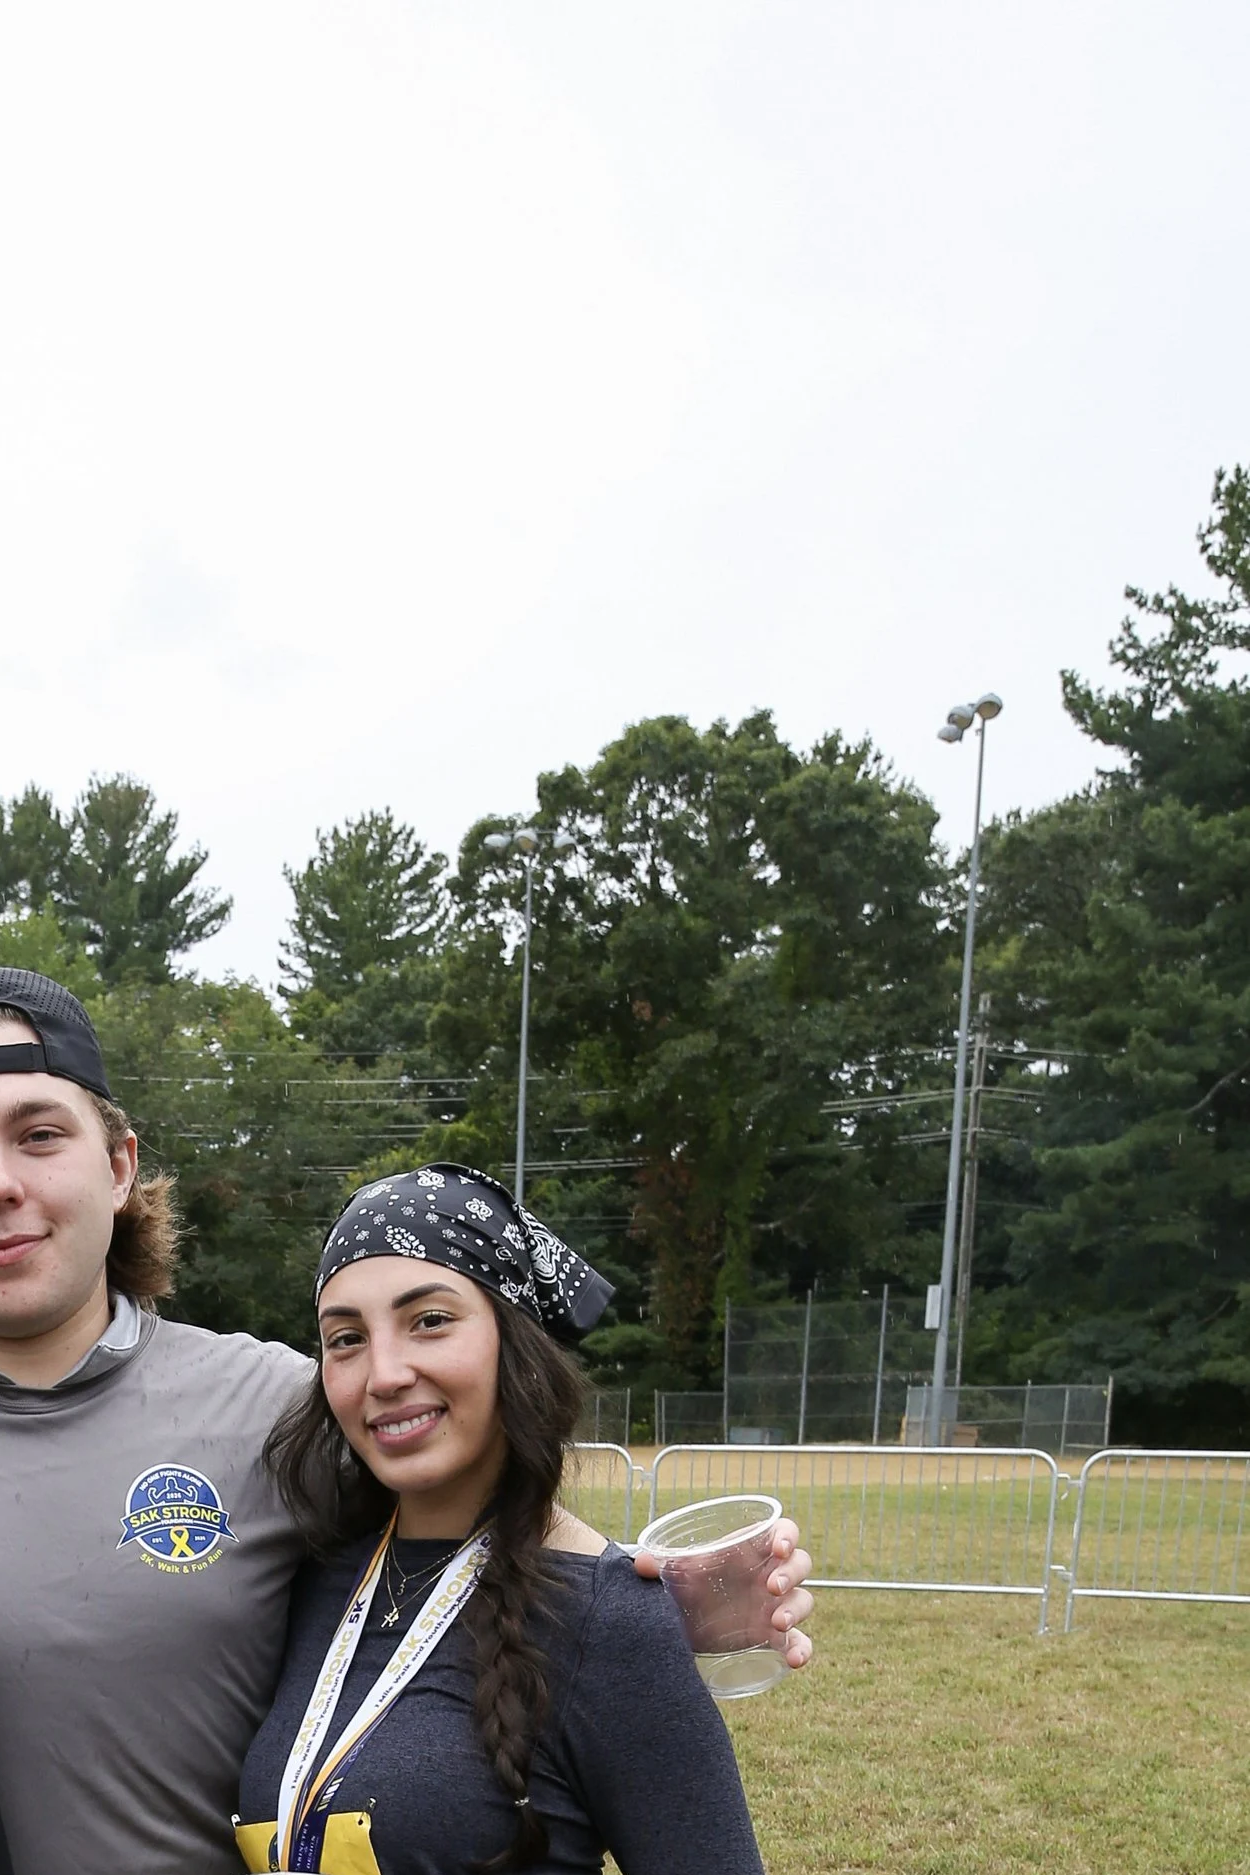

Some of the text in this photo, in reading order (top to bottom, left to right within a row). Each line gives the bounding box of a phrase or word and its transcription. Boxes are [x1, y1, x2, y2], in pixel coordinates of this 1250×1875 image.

[130, 1506, 221, 1528] SAK STRONG
[140, 1548, 223, 1574] 5K, Walk & Fun Run
[293, 1599, 366, 1757] SAK STRONG 5K
[378, 1686, 394, 1704] Mile
[394, 1664, 411, 1684] Walk
[411, 1645, 425, 1662] and
[422, 1620, 445, 1644] Youth
[386, 1634, 423, 1676] SAK
[300, 1740, 312, 1763] Walk
[312, 1722, 322, 1737] and
[320, 1694, 332, 1720] Youth
[331, 1676, 340, 1693] Fun
